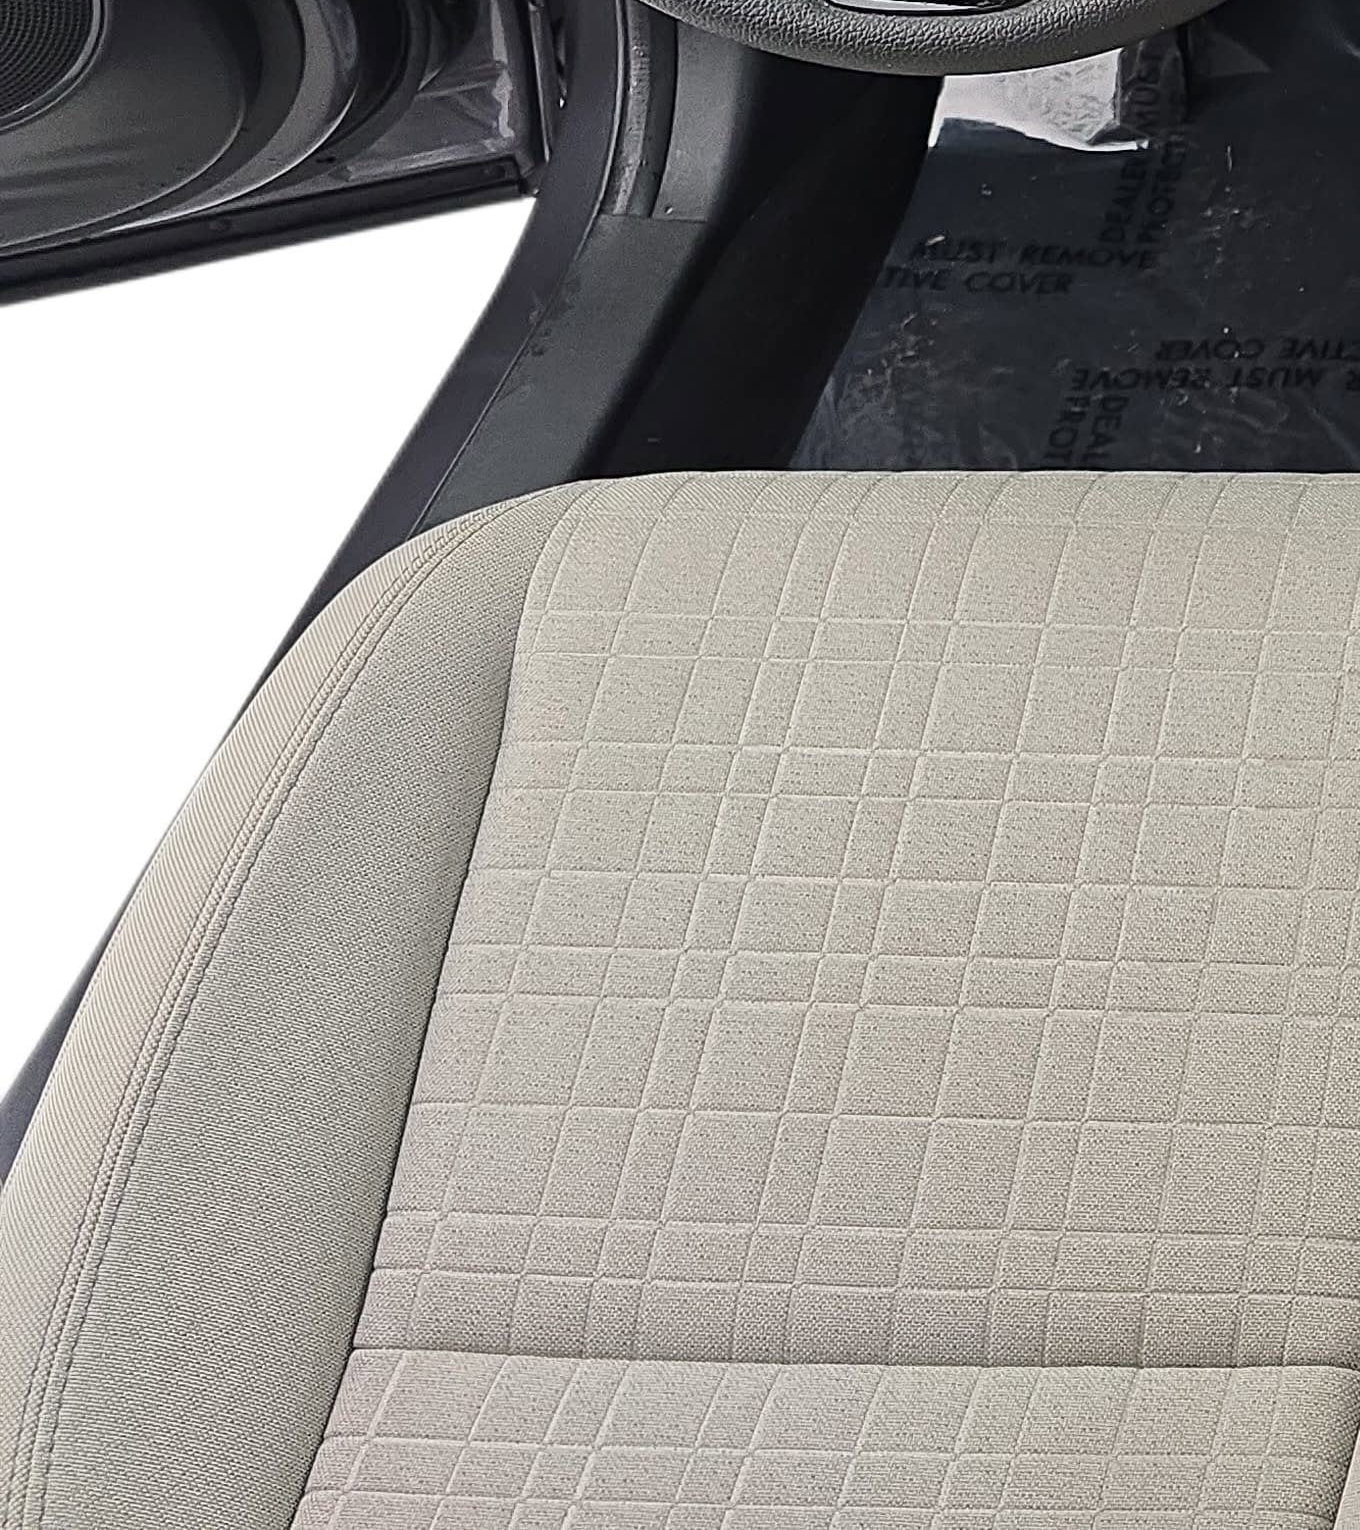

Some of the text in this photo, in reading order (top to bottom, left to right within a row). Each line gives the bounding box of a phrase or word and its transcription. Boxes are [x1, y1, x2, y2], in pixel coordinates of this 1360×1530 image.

[1018, 244, 1161, 271] REMOVE
[963, 271, 1075, 295] COVER
[1154, 338, 1266, 362] COVER
[1232, 367, 1325, 391] MUST
